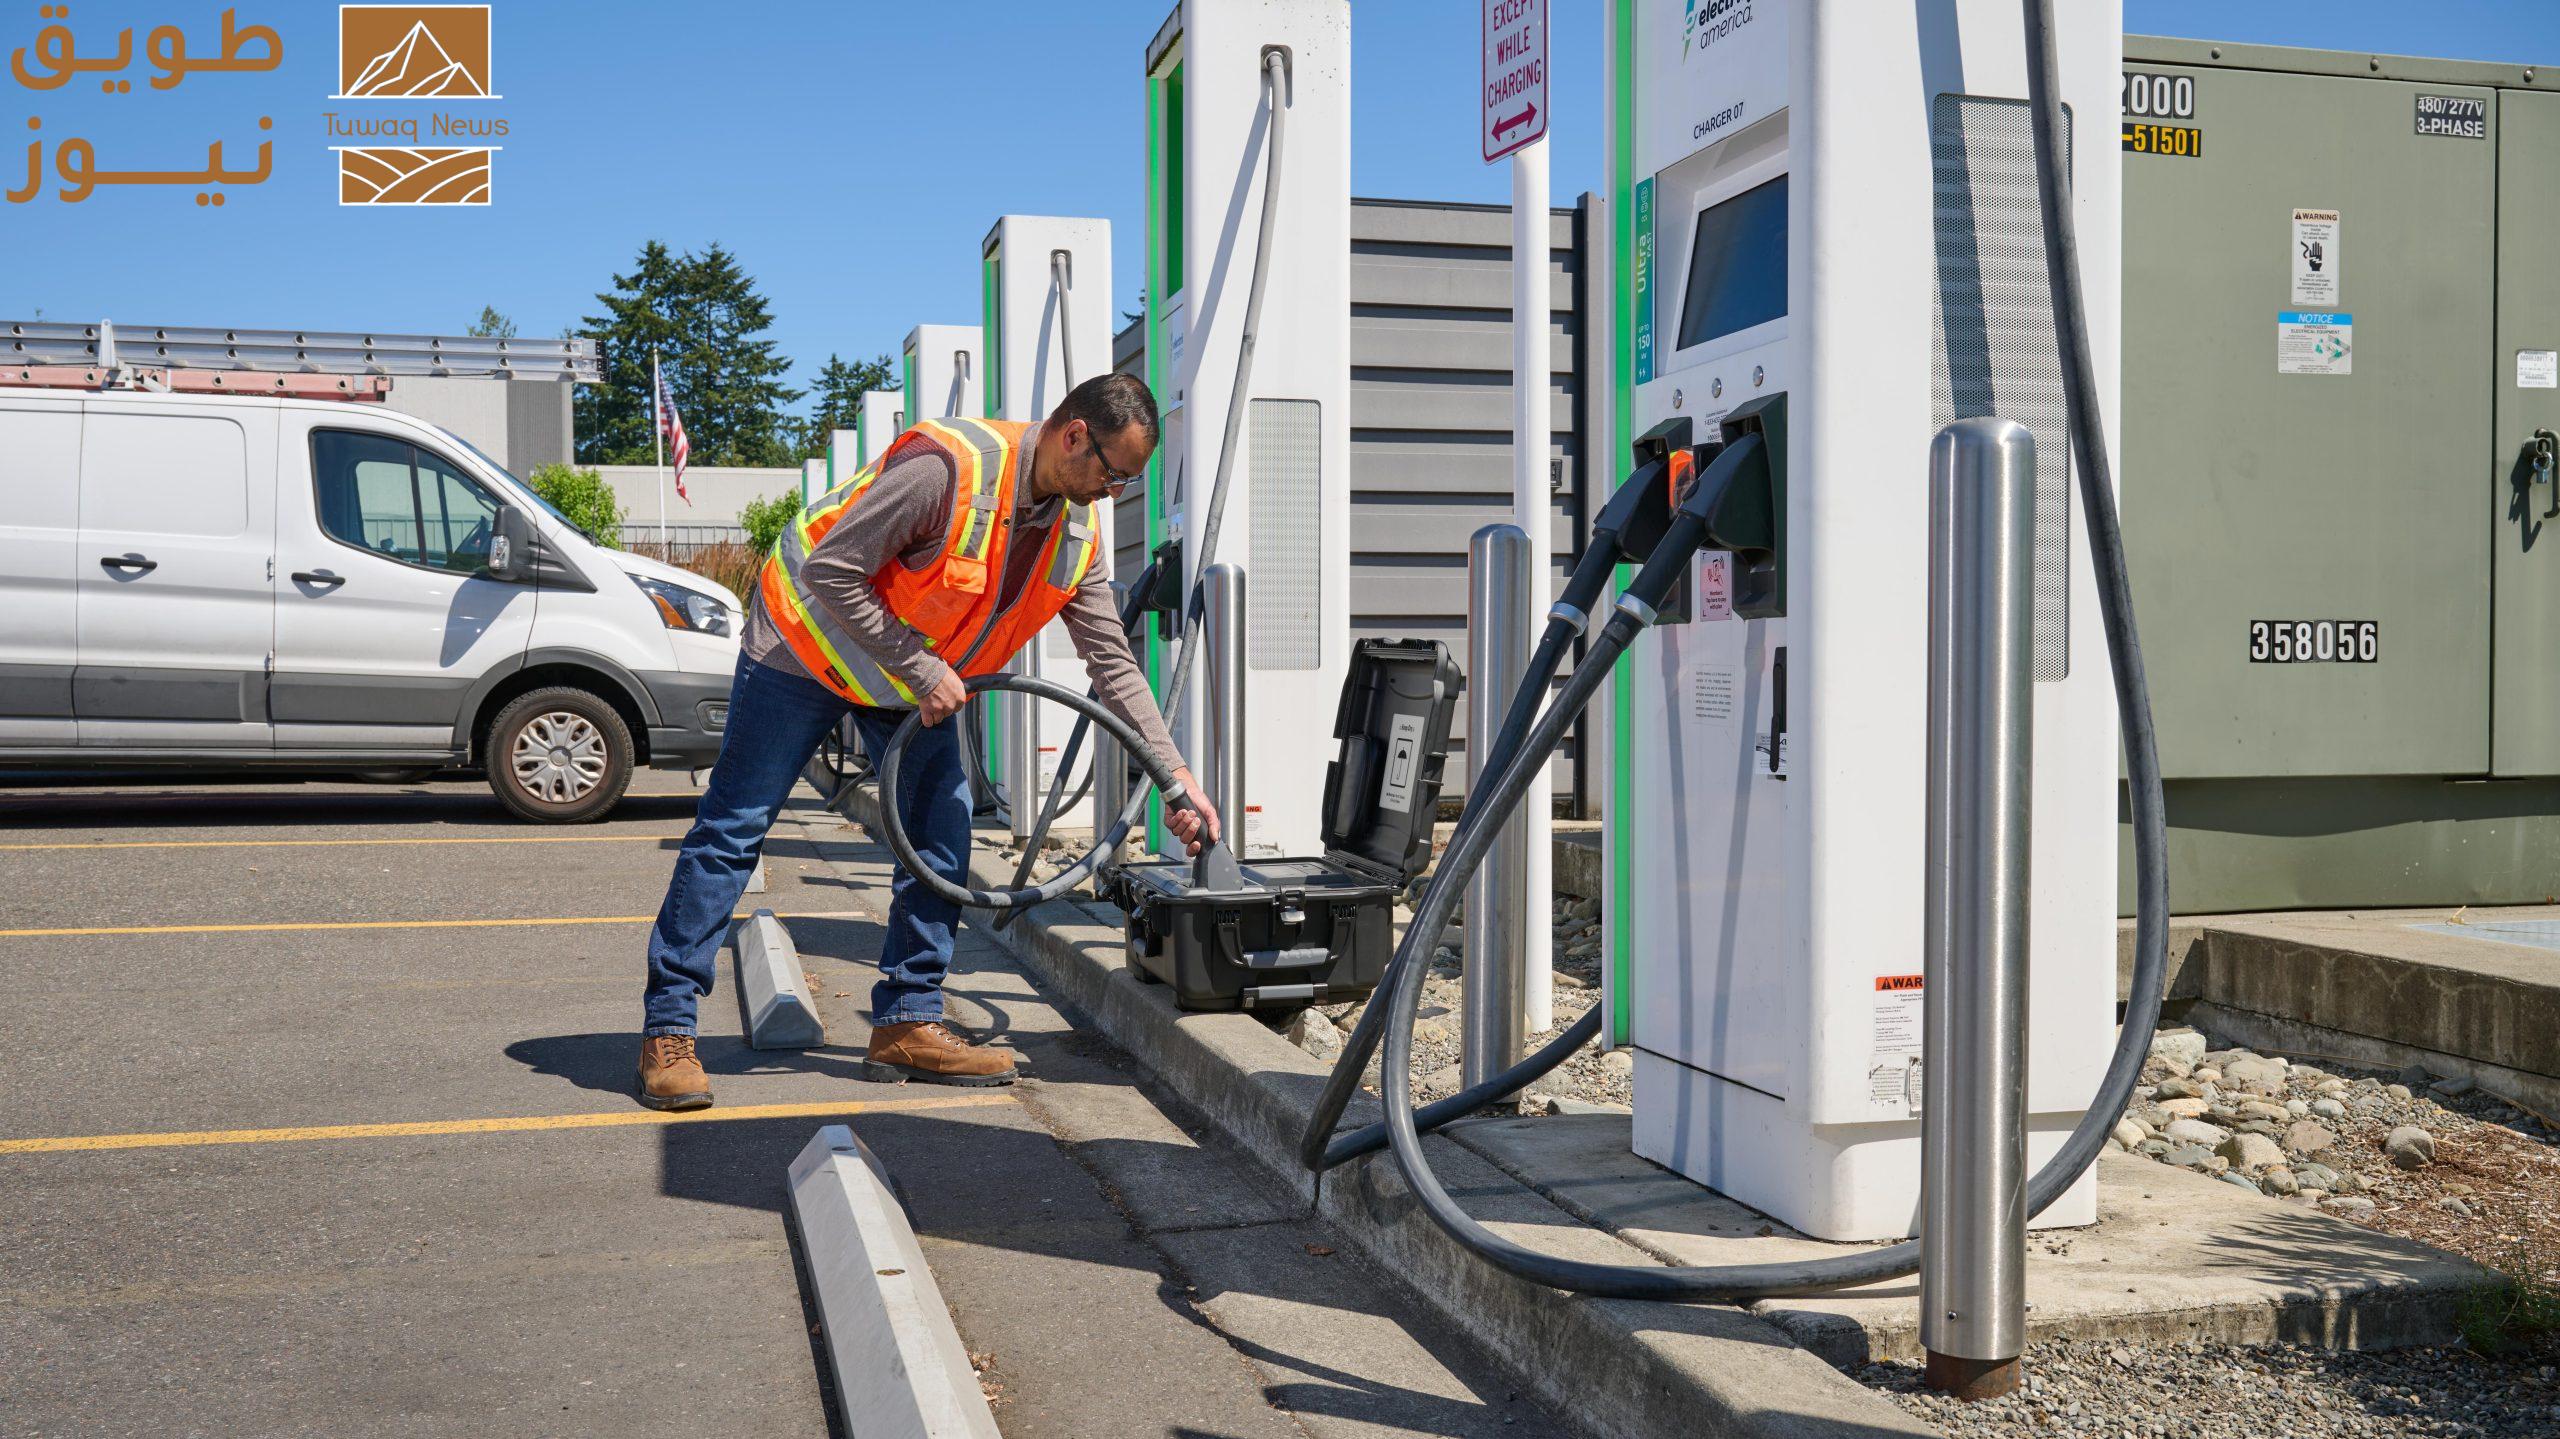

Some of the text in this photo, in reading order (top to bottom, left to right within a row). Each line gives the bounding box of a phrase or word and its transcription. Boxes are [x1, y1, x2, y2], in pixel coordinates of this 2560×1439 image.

[1497, 25, 1530, 66] WHILE
[1700, 5, 1752, 49] america
[1488, 58, 1541, 108] CHARGING
[2122, 74, 2193, 116] 000
[1693, 101, 1744, 139] CHARGER 07
[2417, 117, 2484, 138] 3-PHASE
[2302, 212, 2338, 221] WARNING
[1637, 234, 1647, 293] Ultra
[2298, 313, 2334, 324] NOTICE
[1638, 333, 1650, 350] 150
[2252, 622, 2376, 661] 358056
